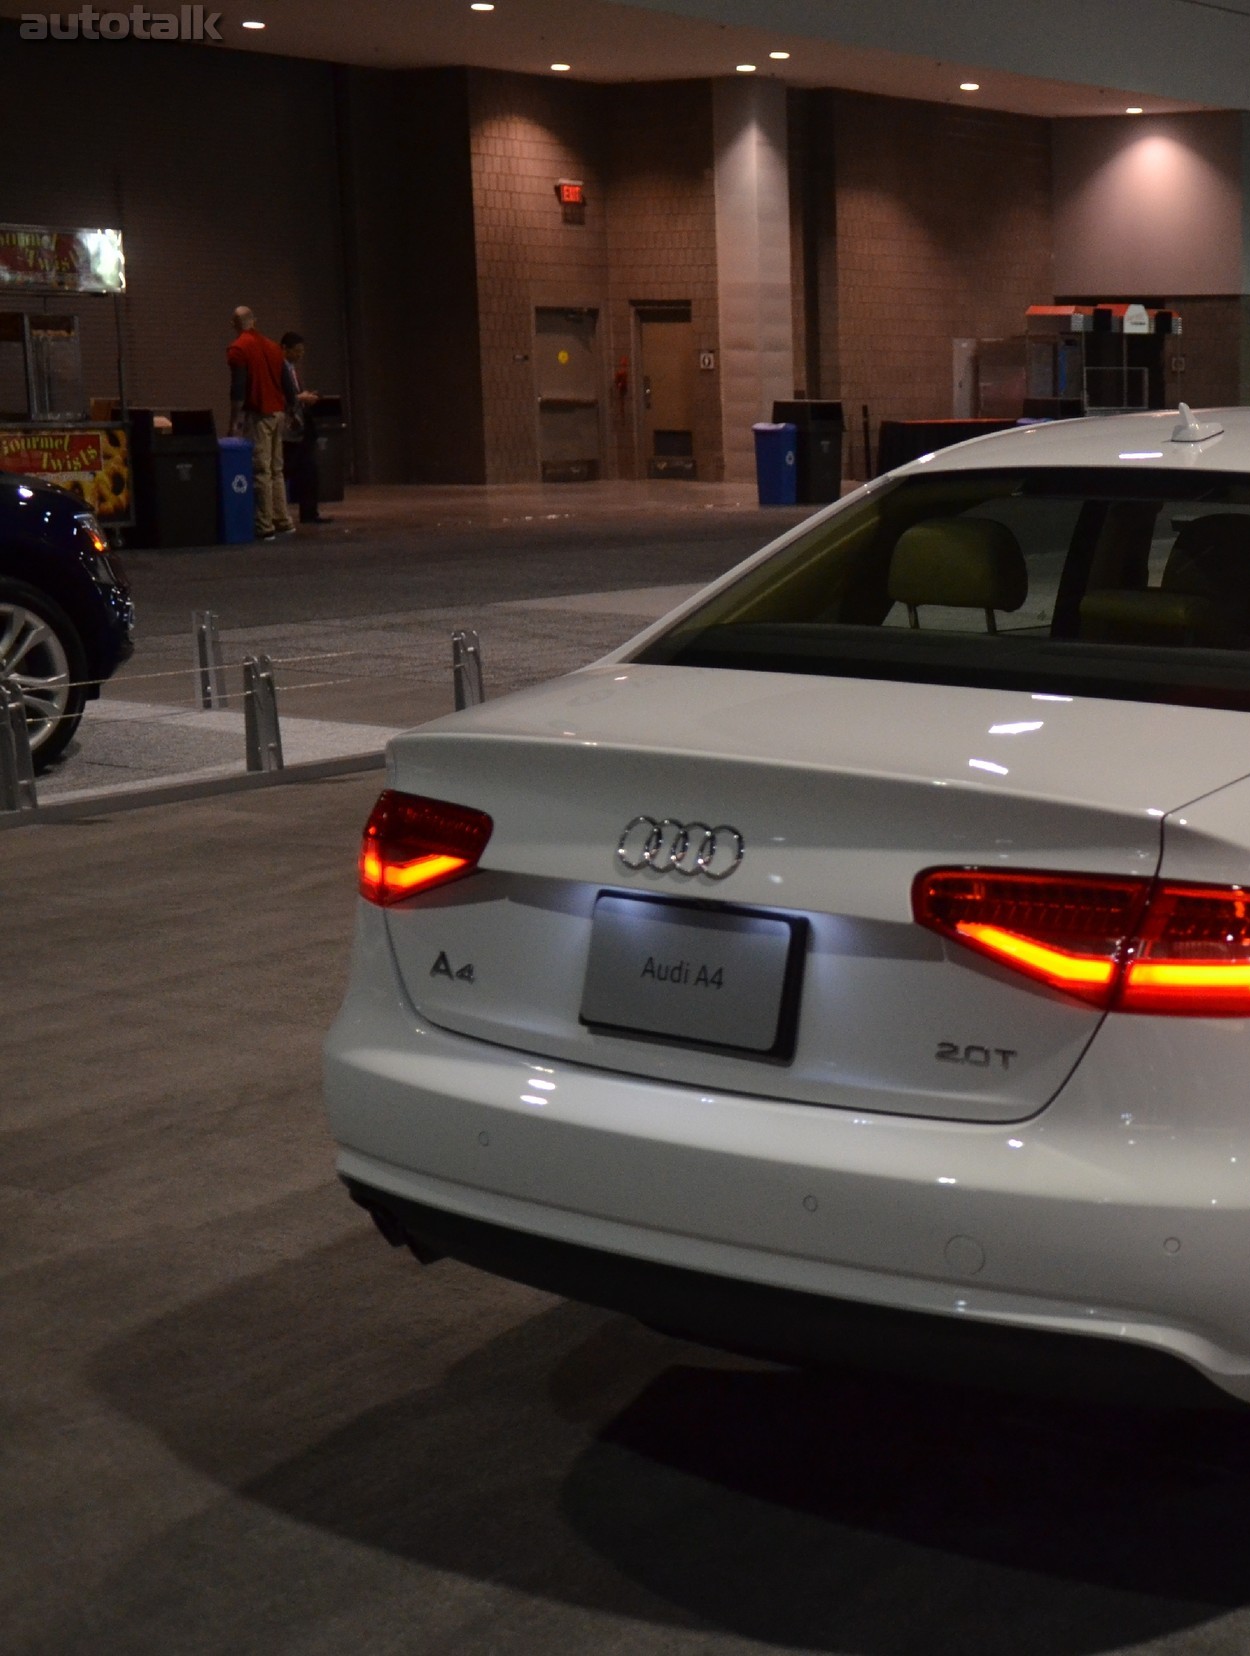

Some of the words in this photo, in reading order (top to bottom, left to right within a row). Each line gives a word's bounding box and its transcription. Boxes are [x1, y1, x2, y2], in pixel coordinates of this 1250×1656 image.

[563, 185, 581, 202] EXIT
[42, 445, 98, 471] Twists
[429, 951, 475, 985] A4
[640, 956, 690, 984] Audi
[693, 964, 724, 990] A4
